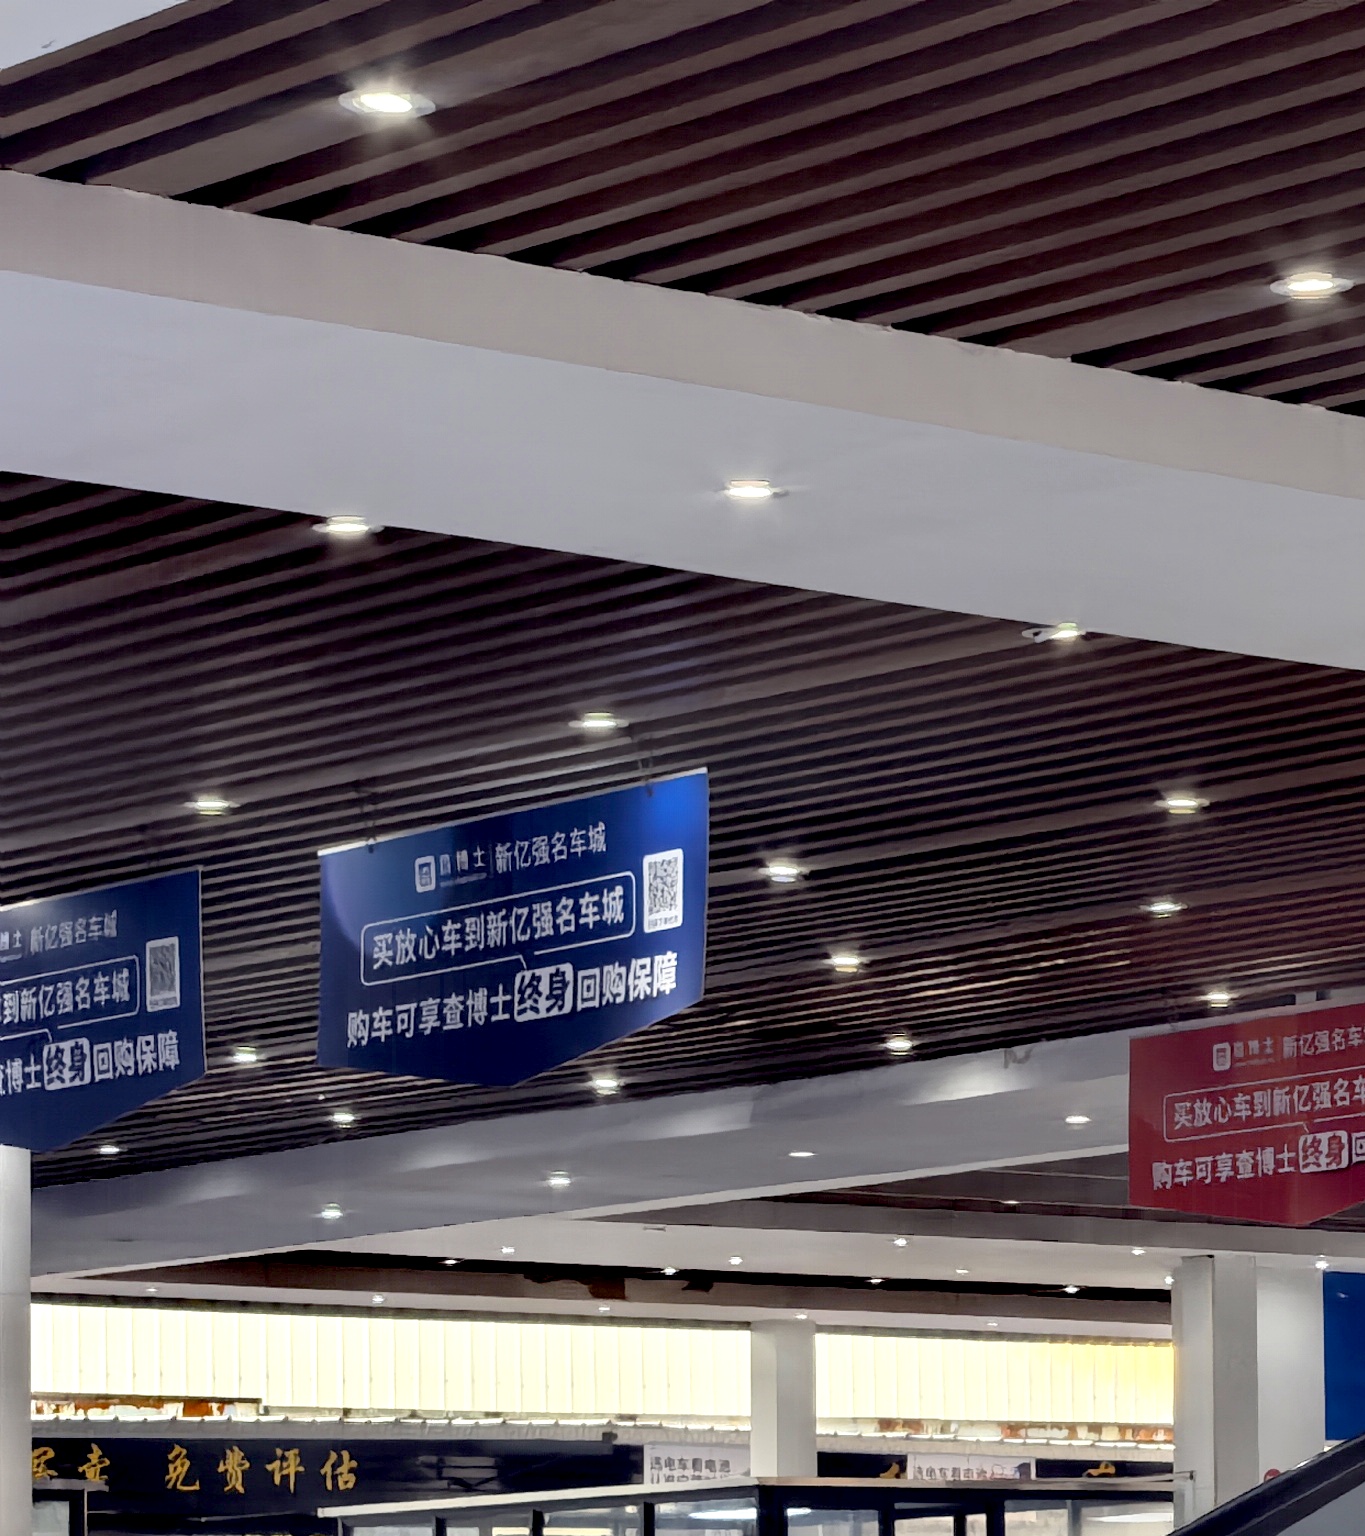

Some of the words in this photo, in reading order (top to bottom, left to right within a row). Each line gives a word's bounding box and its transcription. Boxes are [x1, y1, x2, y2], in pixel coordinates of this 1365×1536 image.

[495, 821, 607, 874] 新亿强名车城
[372, 885, 625, 970] 买放心车到新亿强名车城
[0, 967, 130, 1025] 到新亿强名车城
[347, 950, 679, 1049] 购车可享查博士终身回购保障
[165, 1443, 359, 1495] 免费评估
